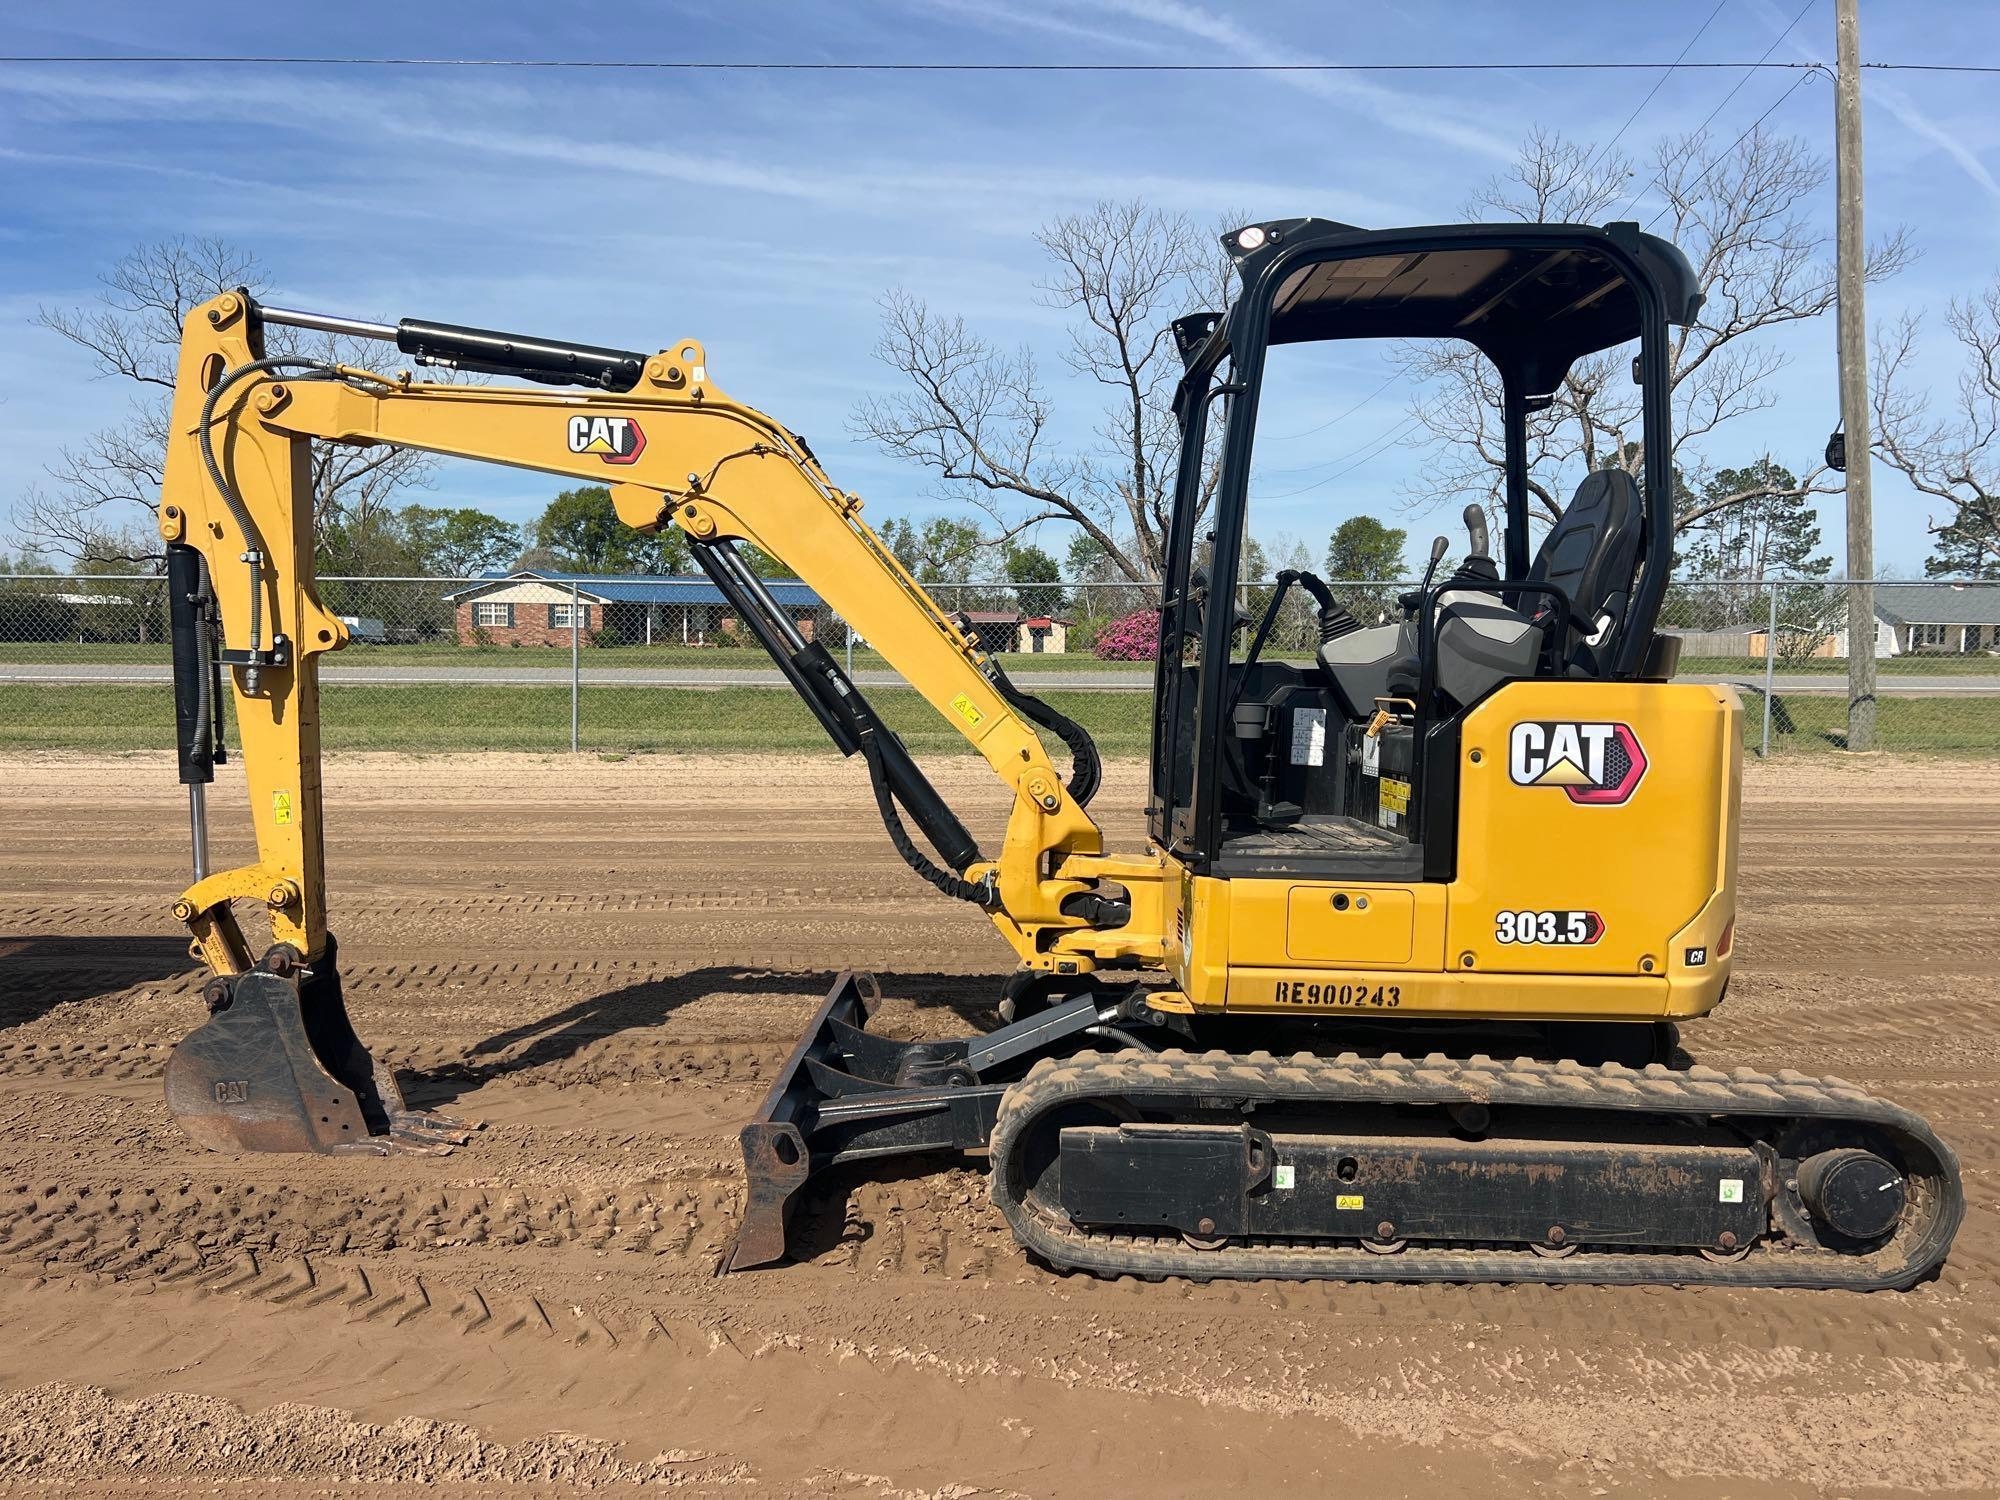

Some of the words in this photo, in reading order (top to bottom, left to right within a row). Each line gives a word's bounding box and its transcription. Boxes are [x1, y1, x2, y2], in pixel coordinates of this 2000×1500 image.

[569, 416, 628, 454] CAT
[1511, 722, 1614, 785] CAT
[1496, 911, 1588, 944] 303.5
[1690, 950, 1704, 964] CR
[1275, 981, 1400, 1007] RE900243
[215, 1081, 249, 1103] CAT
